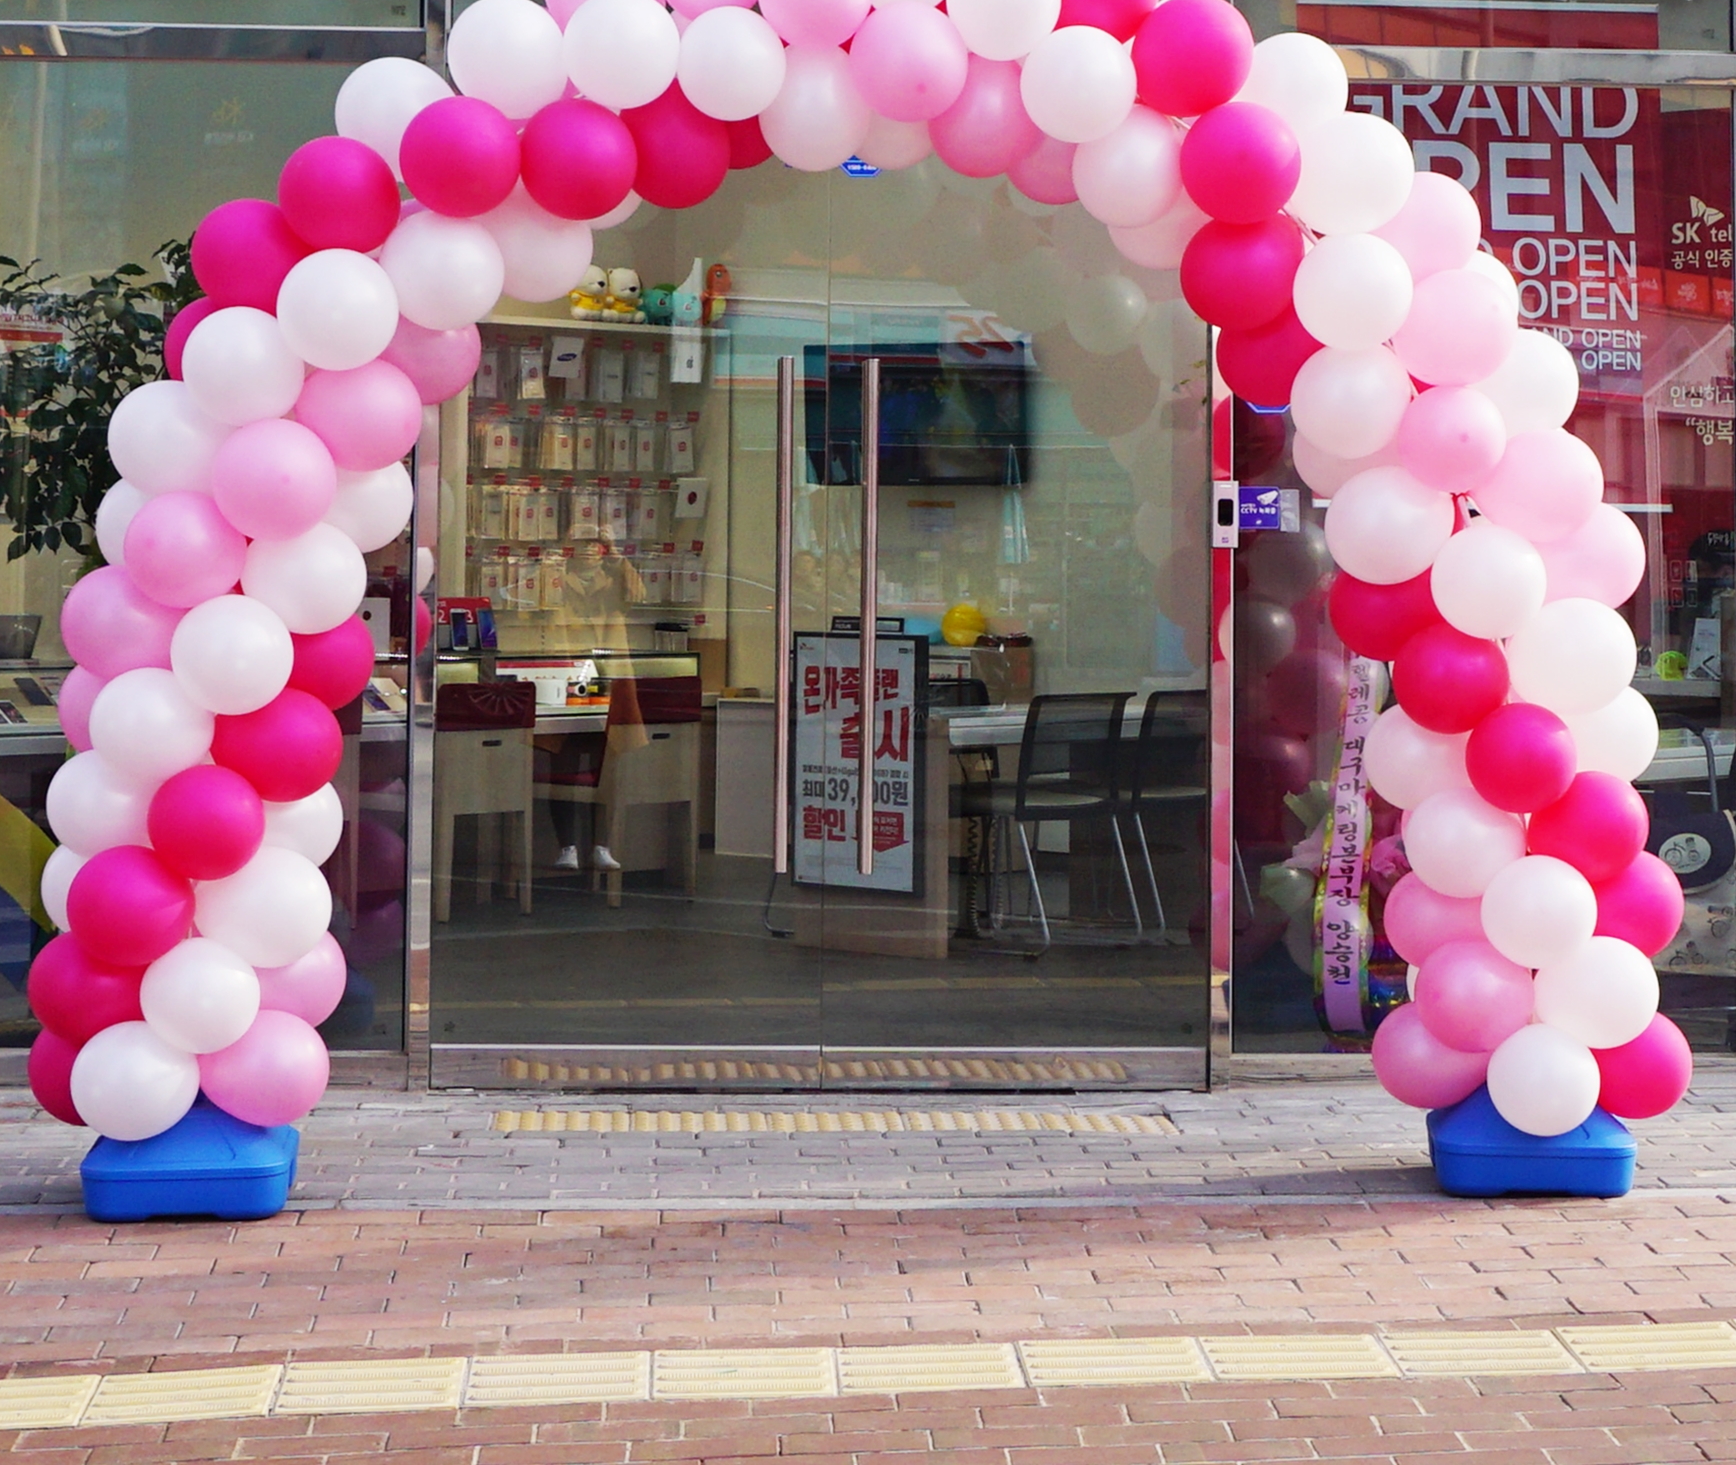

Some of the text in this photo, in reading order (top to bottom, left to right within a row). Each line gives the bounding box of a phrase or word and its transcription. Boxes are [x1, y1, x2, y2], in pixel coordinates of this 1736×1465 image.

[1414, 143, 1638, 234] PEN
[1670, 222, 1702, 245] SK
[1512, 238, 1639, 280] OPEN
[1670, 249, 1734, 270] 공식 인증
[1518, 280, 1640, 323] OPEN
[1581, 329, 1642, 351] OPEN
[1581, 350, 1642, 372] OPEN
[1240, 506, 1258, 515] CCTV
[802, 804, 848, 843] 할인
